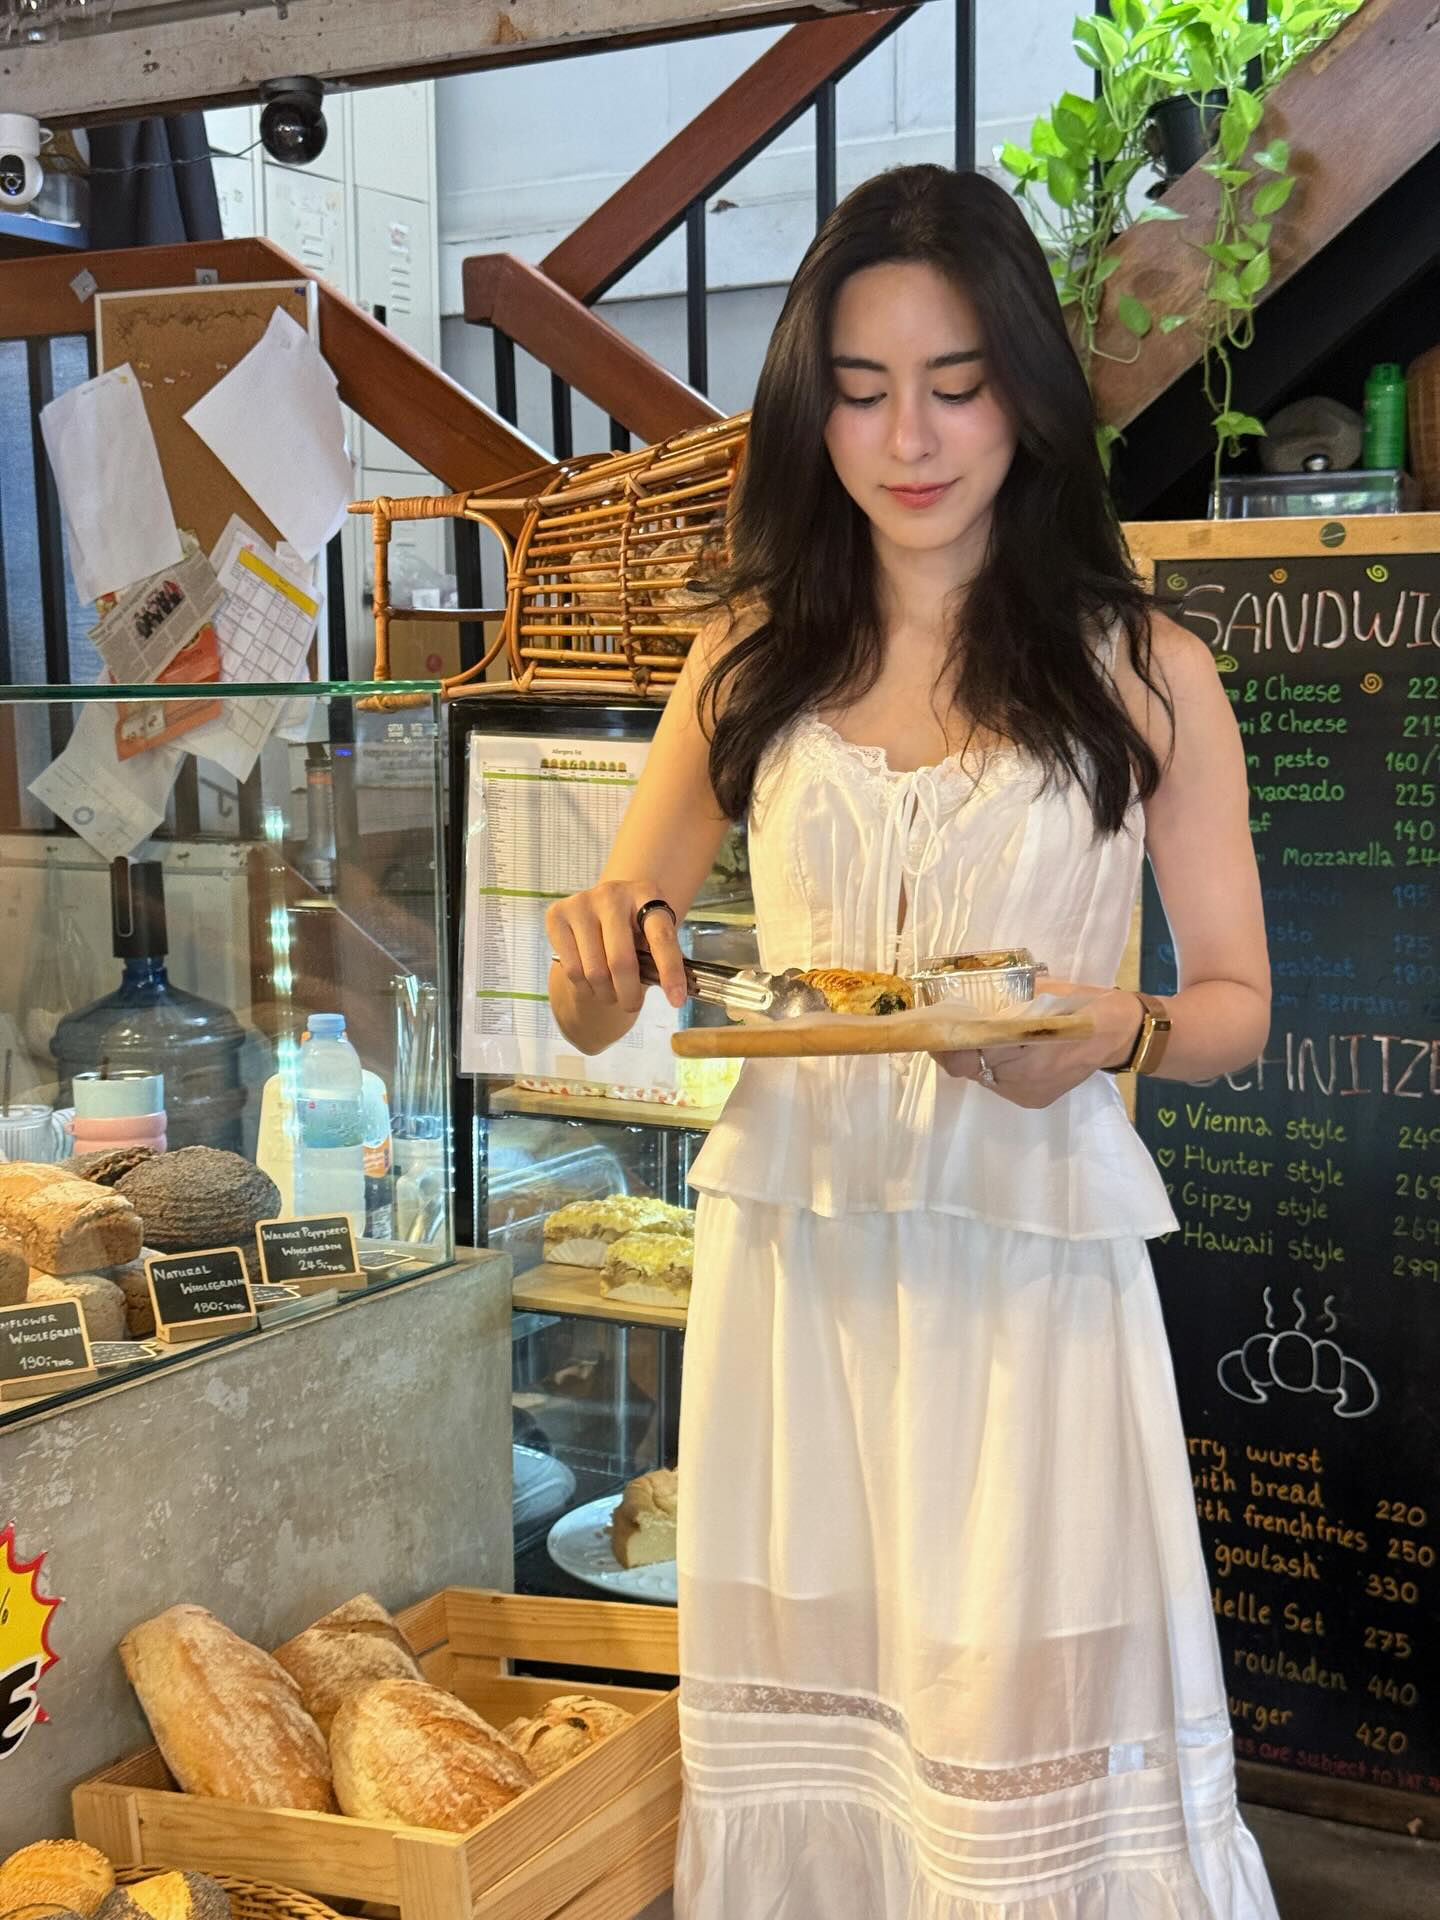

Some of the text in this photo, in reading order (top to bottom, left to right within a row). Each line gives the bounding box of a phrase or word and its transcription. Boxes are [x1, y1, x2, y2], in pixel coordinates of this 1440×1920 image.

[1266, 673, 1342, 703] Cheese
[1278, 708, 1348, 733] Cheese
[1274, 748, 1330, 776] pesto
[1385, 744, 1440, 776] 160/
[1252, 779, 1435, 807] vaocado 225
[1393, 820, 1434, 841] 140
[1282, 841, 1395, 867] Mozzarella
[1406, 846, 1440, 867] 24
[1186, 1102, 1273, 1137] Vienna
[1285, 1118, 1348, 1150] style
[1184, 1144, 1273, 1178] Hunter
[1284, 1157, 1345, 1194] style
[1182, 1181, 1252, 1222] Gipzy
[1276, 1199, 1328, 1227] style
[1184, 1221, 1274, 1256] Hawaii
[1287, 1239, 1345, 1272] style
[153, 1265, 212, 1281] NATURAL
[180, 1279, 245, 1295] WHOLEGRAIN
[9, 1327, 81, 1345] WHOLEGRAIN
[1187, 1437, 1324, 1473] rry wurst
[1250, 1473, 1325, 1508] bread
[1376, 1500, 1427, 1527] 220
[1197, 1497, 1232, 1523] ith
[1387, 1538, 1436, 1568] 250
[1214, 1541, 1418, 1604] goulash 330
[1284, 1602, 1326, 1636] Set
[1364, 1626, 1412, 1659] 275
[1234, 1649, 1418, 1706] rouladen 440
[1229, 1696, 1408, 1755] urger 420
